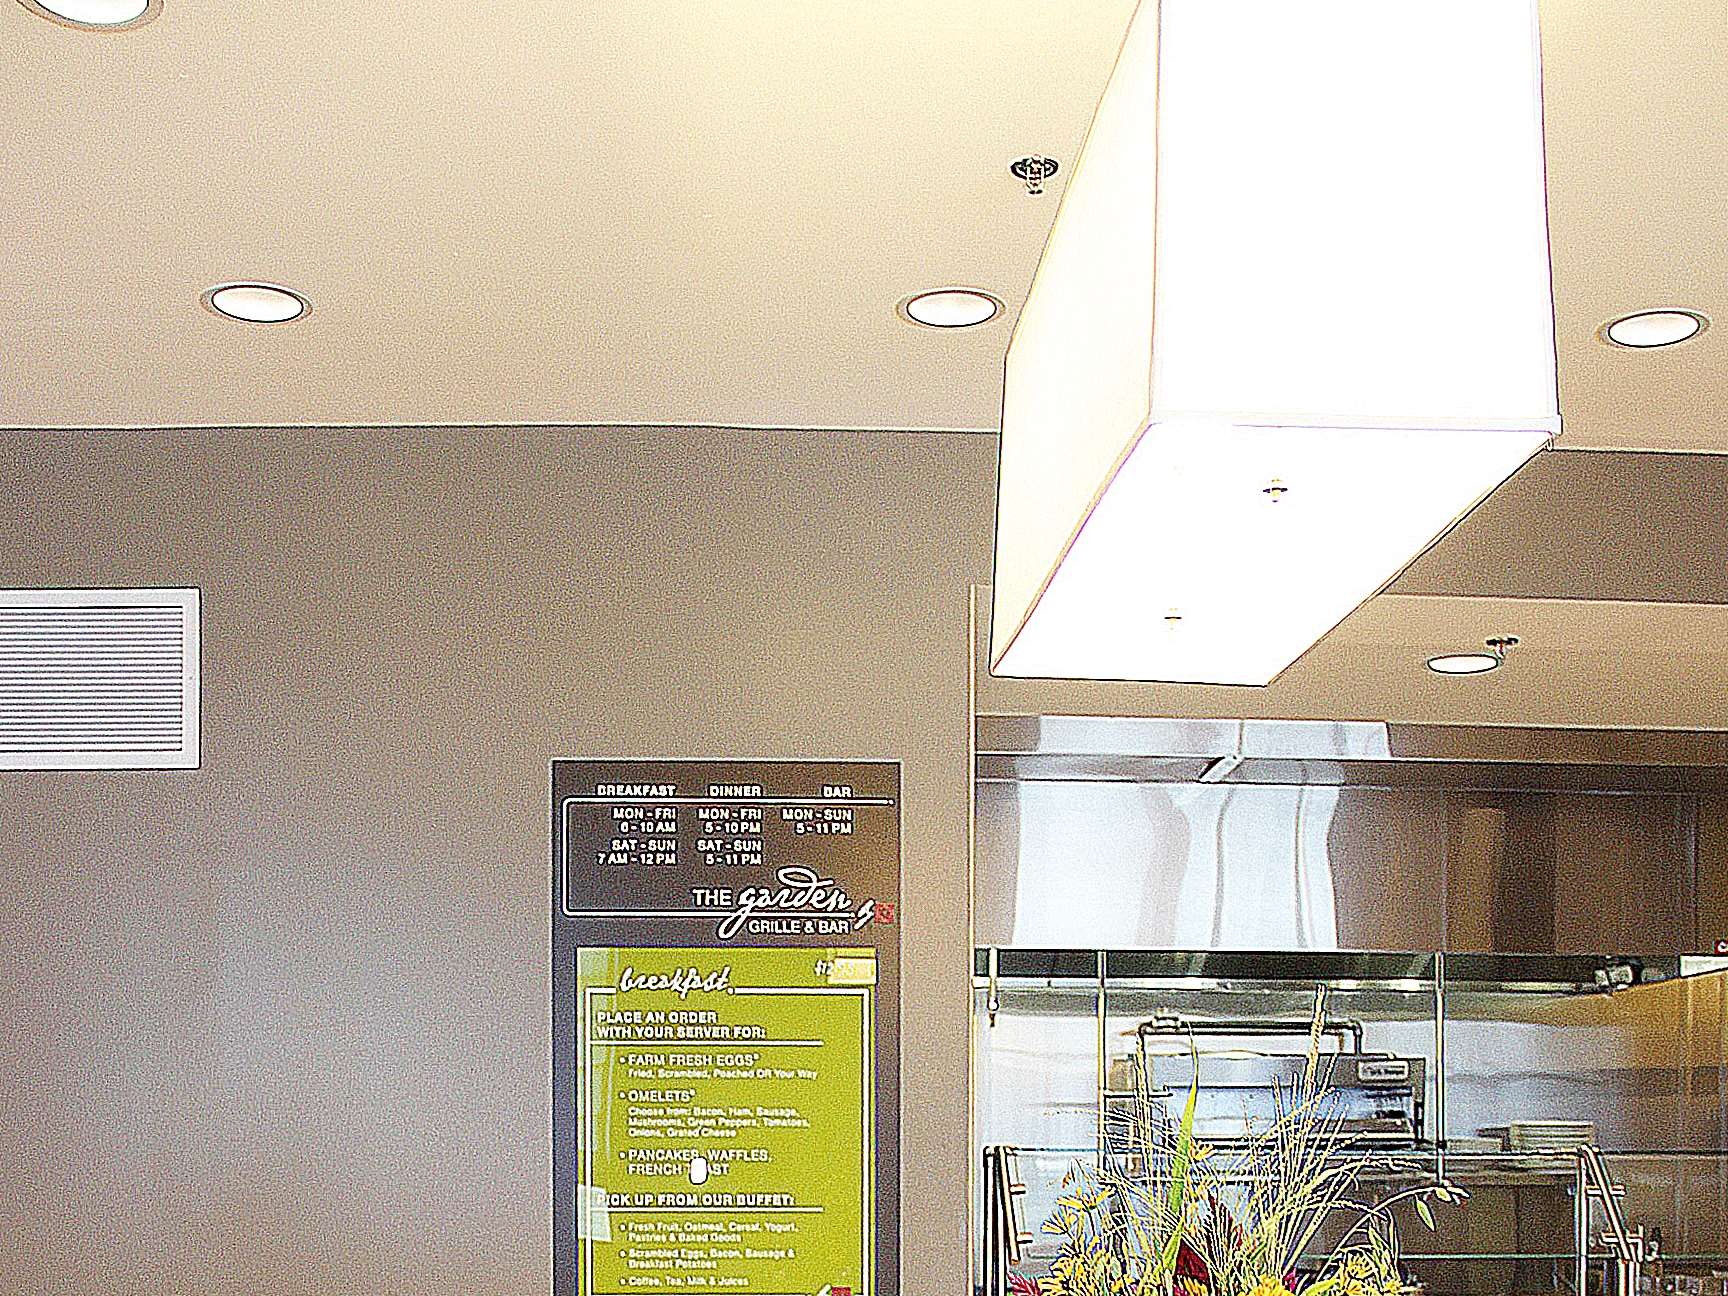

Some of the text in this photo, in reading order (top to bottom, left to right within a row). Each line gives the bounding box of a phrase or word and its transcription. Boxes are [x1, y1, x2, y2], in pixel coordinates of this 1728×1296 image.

[596, 785, 677, 797] BREAKFAST
[709, 785, 762, 797] DINNER
[823, 786, 852, 798] BAR
[613, 807, 644, 820] MON
[655, 807, 676, 820] FRI
[698, 807, 730, 820] MON
[740, 807, 762, 820] FRI
[782, 808, 813, 821] MON
[824, 808, 852, 821] SUN
[640, 821, 654, 833] 10
[655, 821, 677, 833] AM
[705, 821, 714, 833] 5
[725, 821, 739, 833] 10
[741, 821, 761, 833] PM
[796, 822, 805, 834] 5
[815, 822, 829, 834] 11
[831, 822, 852, 834] PM
[611, 839, 638, 852] SAT
[648, 839, 676, 852] SUN
[697, 839, 724, 852] SAT
[733, 839, 762, 852] SUN
[597, 853, 606, 865] 7
[607, 853, 628, 865] AM
[640, 853, 654, 865] 12
[656, 853, 676, 865] PM
[705, 853, 714, 865] 5
[725, 853, 738, 865] 11
[741, 853, 762, 865] PM
[693, 866, 853, 939] THE garden
[748, 920, 849, 933] GRILLE & BAR
[597, 1011, 717, 1024] PLACE AN ORDER
[597, 1026, 632, 1038] WITH
[635, 1026, 674, 1038] YOUR
[676, 1026, 729, 1038] SERVER
[629, 1054, 665, 1066] FARM
[669, 1054, 712, 1066] FRESH
[707, 1149, 772, 1163] WAFFLES,
[628, 1163, 683, 1176] FRENCH
[634, 1193, 654, 1206] UP
[657, 1193, 699, 1206] FROM
[701, 1193, 734, 1206] OUR
